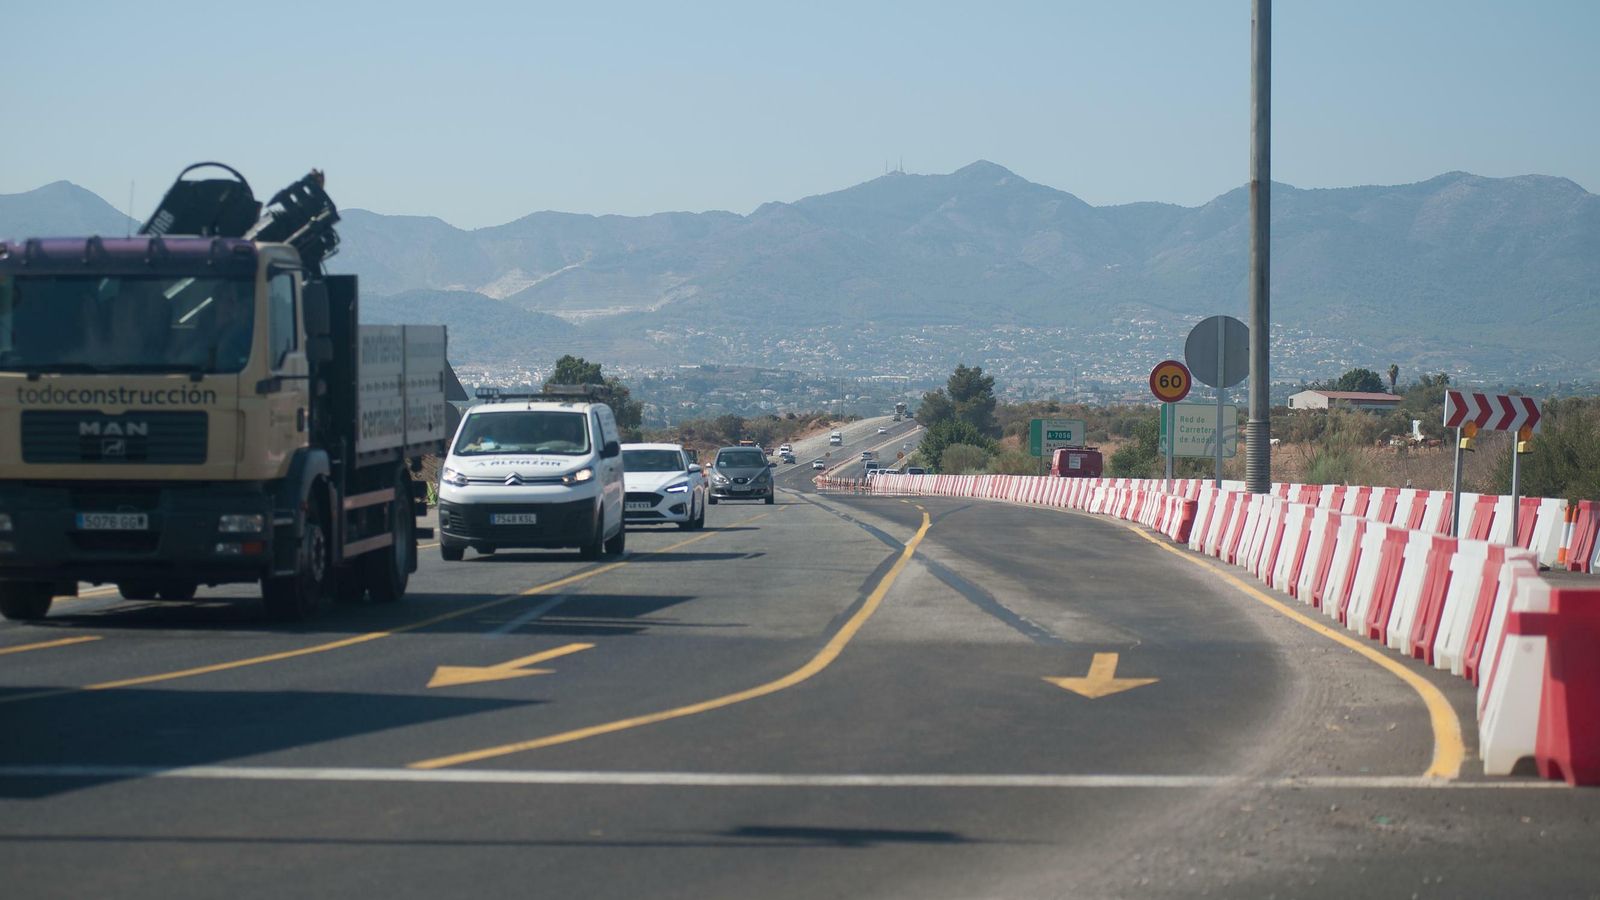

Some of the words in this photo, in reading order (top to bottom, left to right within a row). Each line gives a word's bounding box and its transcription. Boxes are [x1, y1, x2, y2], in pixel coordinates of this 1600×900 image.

[1160, 374, 1182, 388] 60
[17, 384, 217, 405] todoconstrucción
[1180, 416, 1194, 424] Red
[1196, 416, 1205, 424] de
[79, 422, 148, 436] MAN
[1179, 425, 1216, 434] Carretera
[1179, 435, 1189, 444] de
